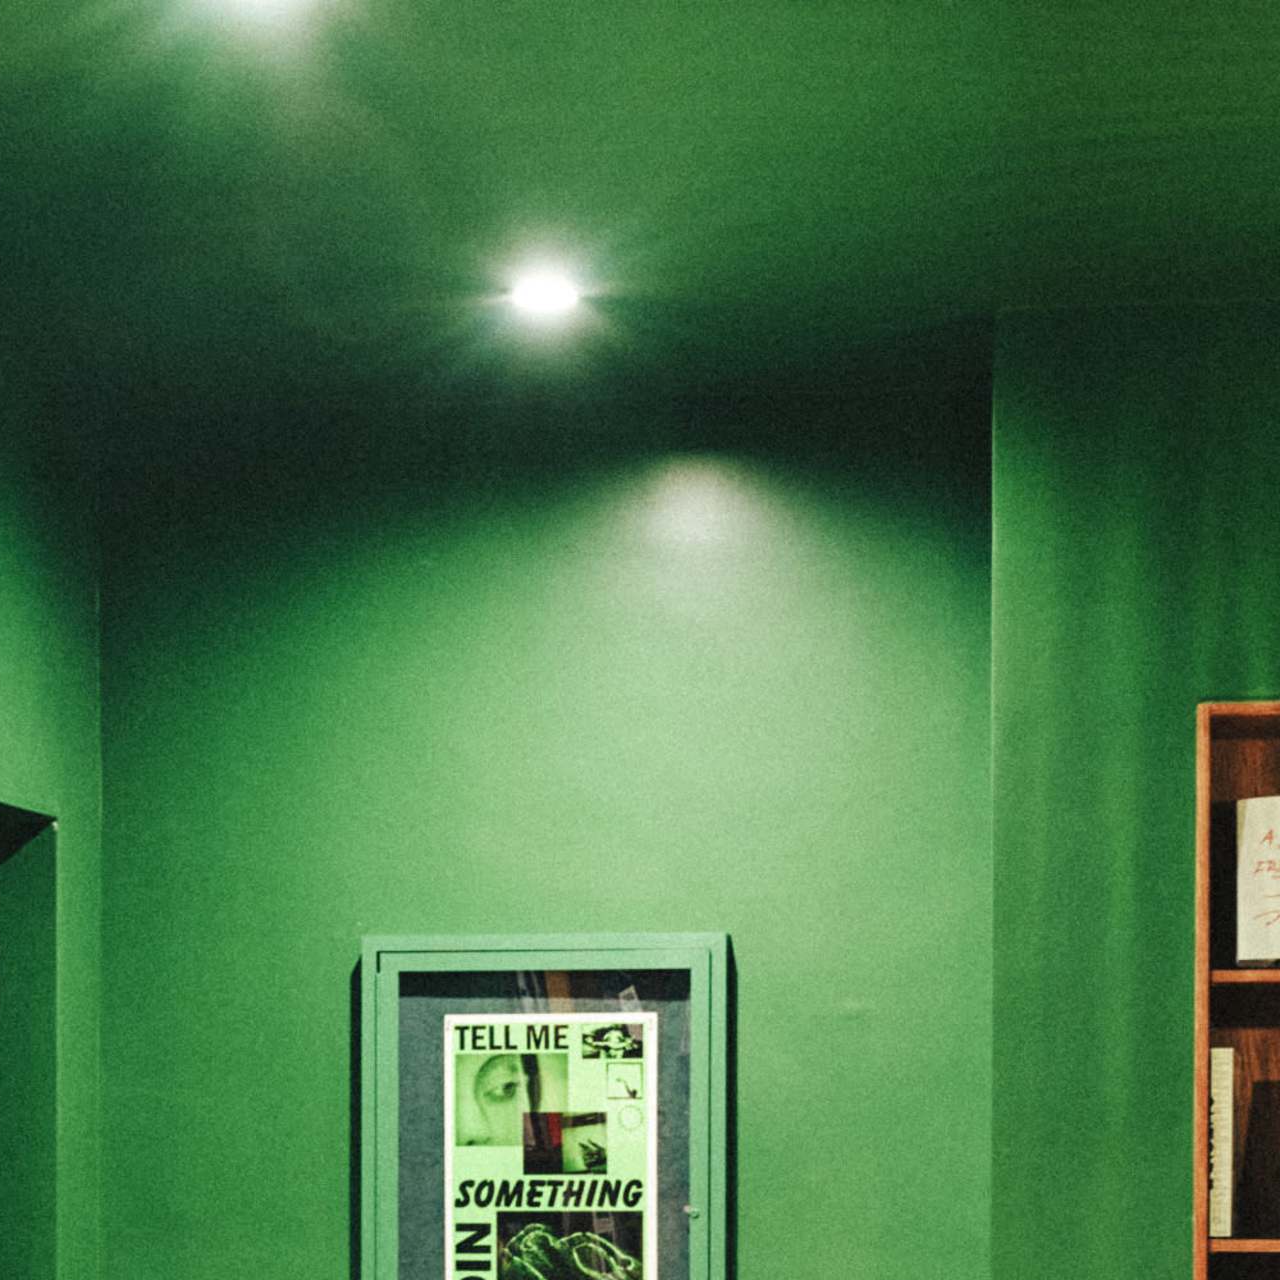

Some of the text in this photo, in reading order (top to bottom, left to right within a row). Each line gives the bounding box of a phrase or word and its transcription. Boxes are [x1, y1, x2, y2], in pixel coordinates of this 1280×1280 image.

[454, 1024, 569, 1050] TELL ME
[454, 1178, 644, 1208] SOMETHING
